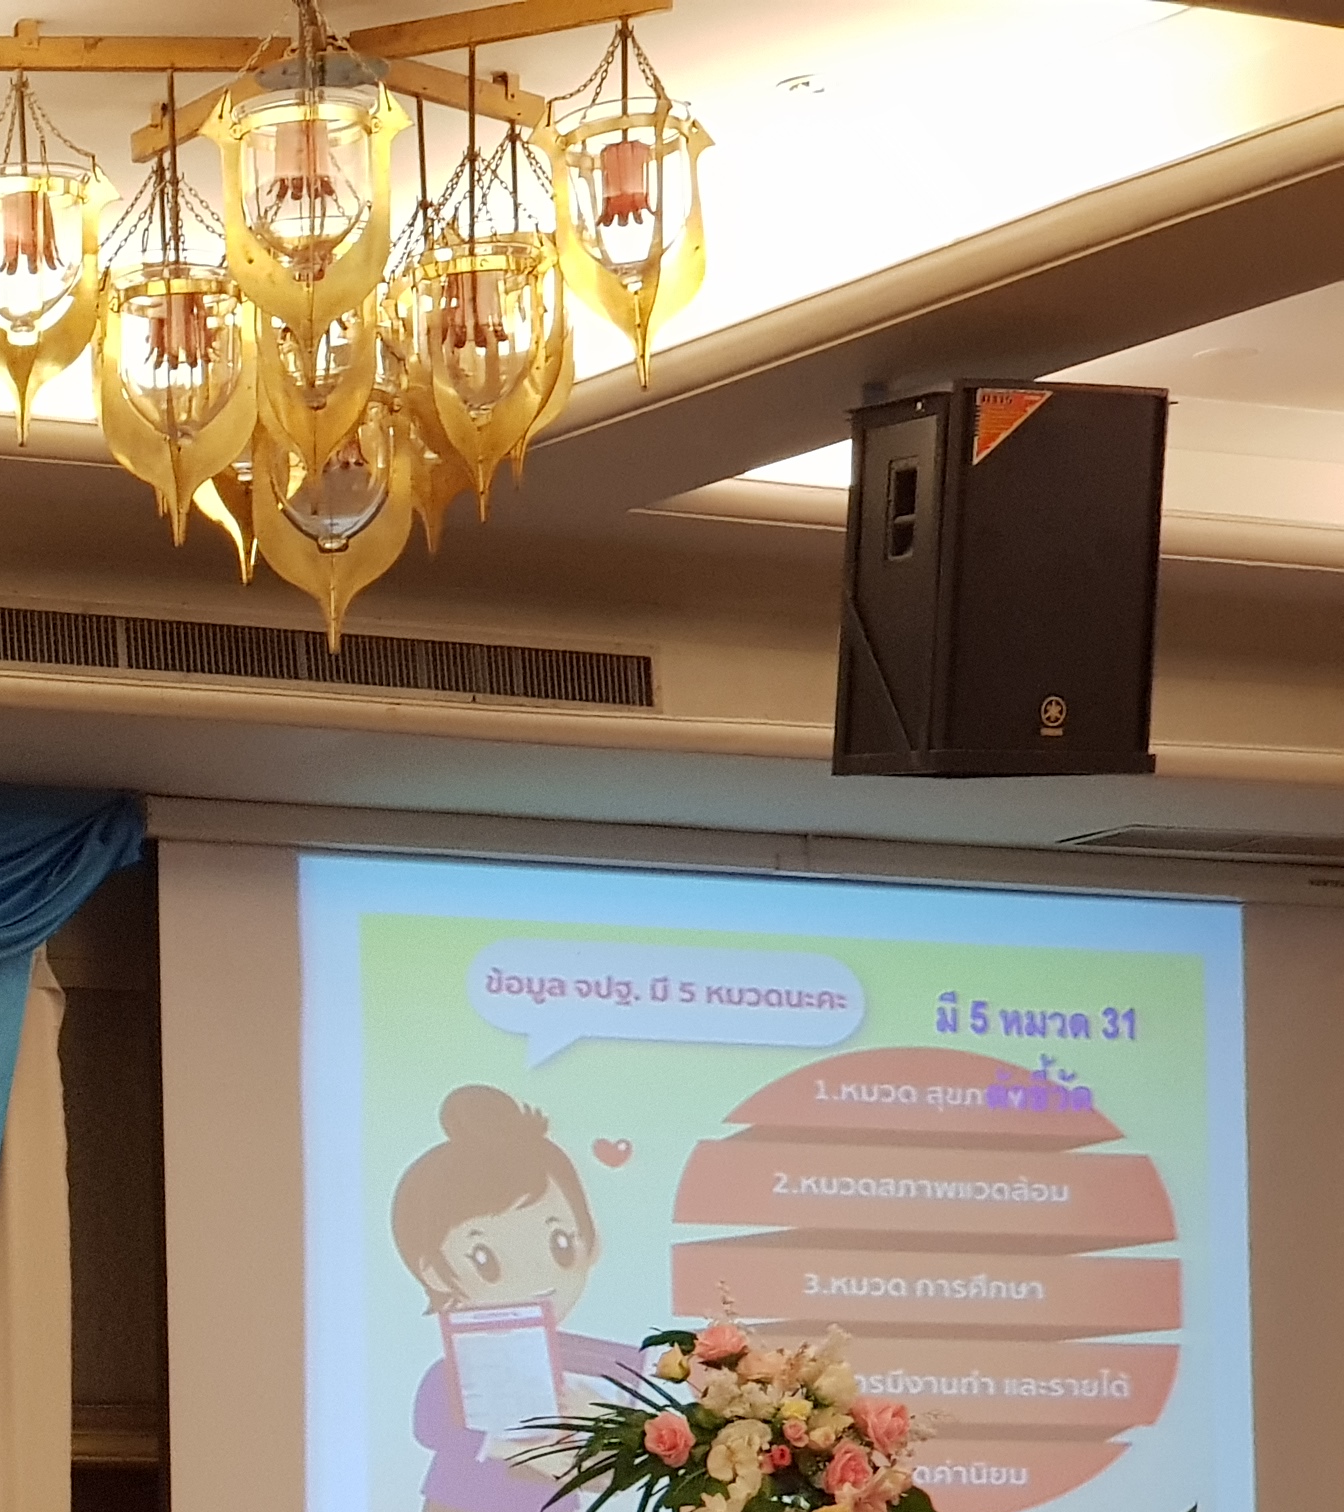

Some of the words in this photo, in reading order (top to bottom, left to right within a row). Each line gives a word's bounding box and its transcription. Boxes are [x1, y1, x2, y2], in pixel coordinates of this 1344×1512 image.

[486, 967, 566, 1005] ข้อมูล
[575, 977, 641, 1006] จปฐ.
[650, 976, 669, 1002] มี
[679, 981, 696, 1003] 5
[705, 985, 847, 1009] หมวดนะคะ
[936, 990, 957, 1033] มี
[970, 1001, 989, 1034] 5
[999, 1009, 1089, 1039] หมวด
[1102, 1007, 1136, 1040] 31
[772, 1173, 1070, 1202] 2.หมวดสภาพแวดล้อม
[853, 1369, 996, 1396] ารมีงานทำ
